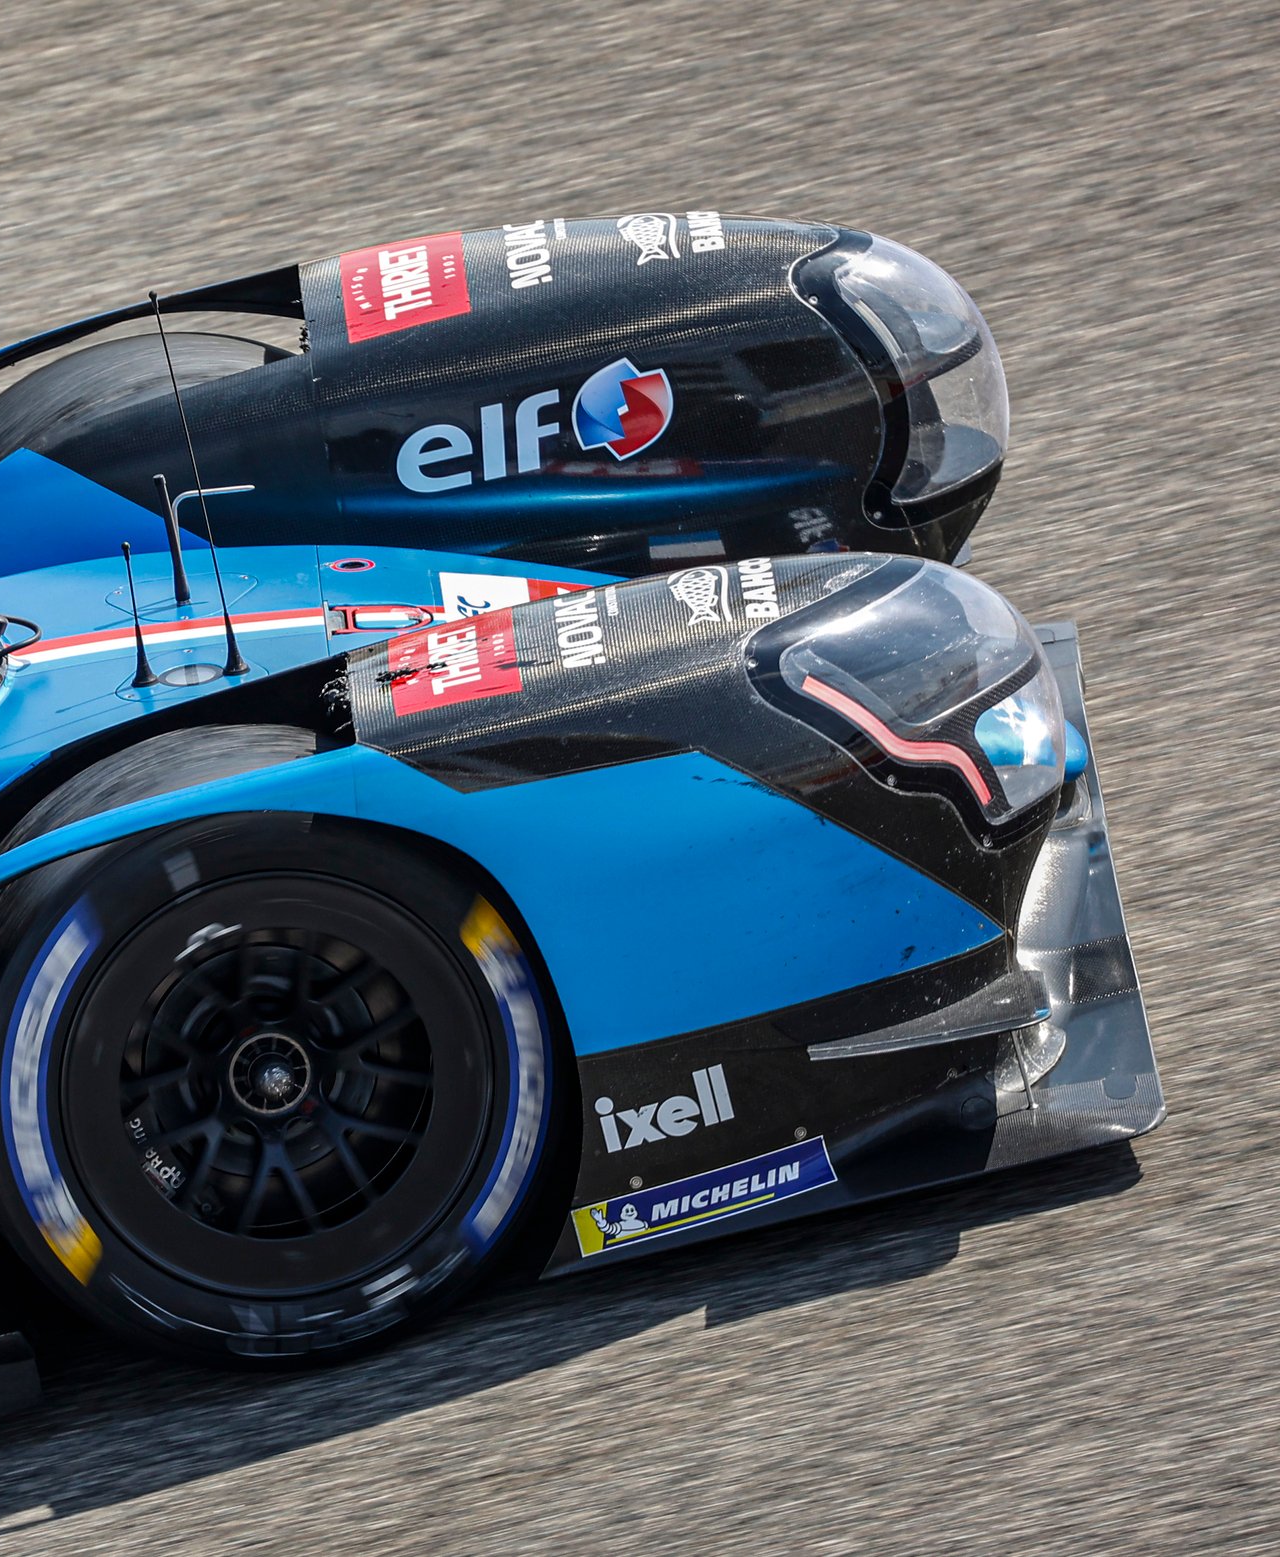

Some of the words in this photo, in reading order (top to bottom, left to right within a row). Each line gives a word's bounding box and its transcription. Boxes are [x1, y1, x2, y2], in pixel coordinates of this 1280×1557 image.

[351, 267, 373, 309] MAISON
[378, 245, 433, 320] THIRIET
[442, 254, 456, 280] 1902
[396, 389, 559, 493] elf
[737, 557, 780, 618] BAHCO
[492, 632, 505, 657] 1902
[593, 1063, 735, 1154] ixell
[650, 1160, 801, 1222] MICHELIN
